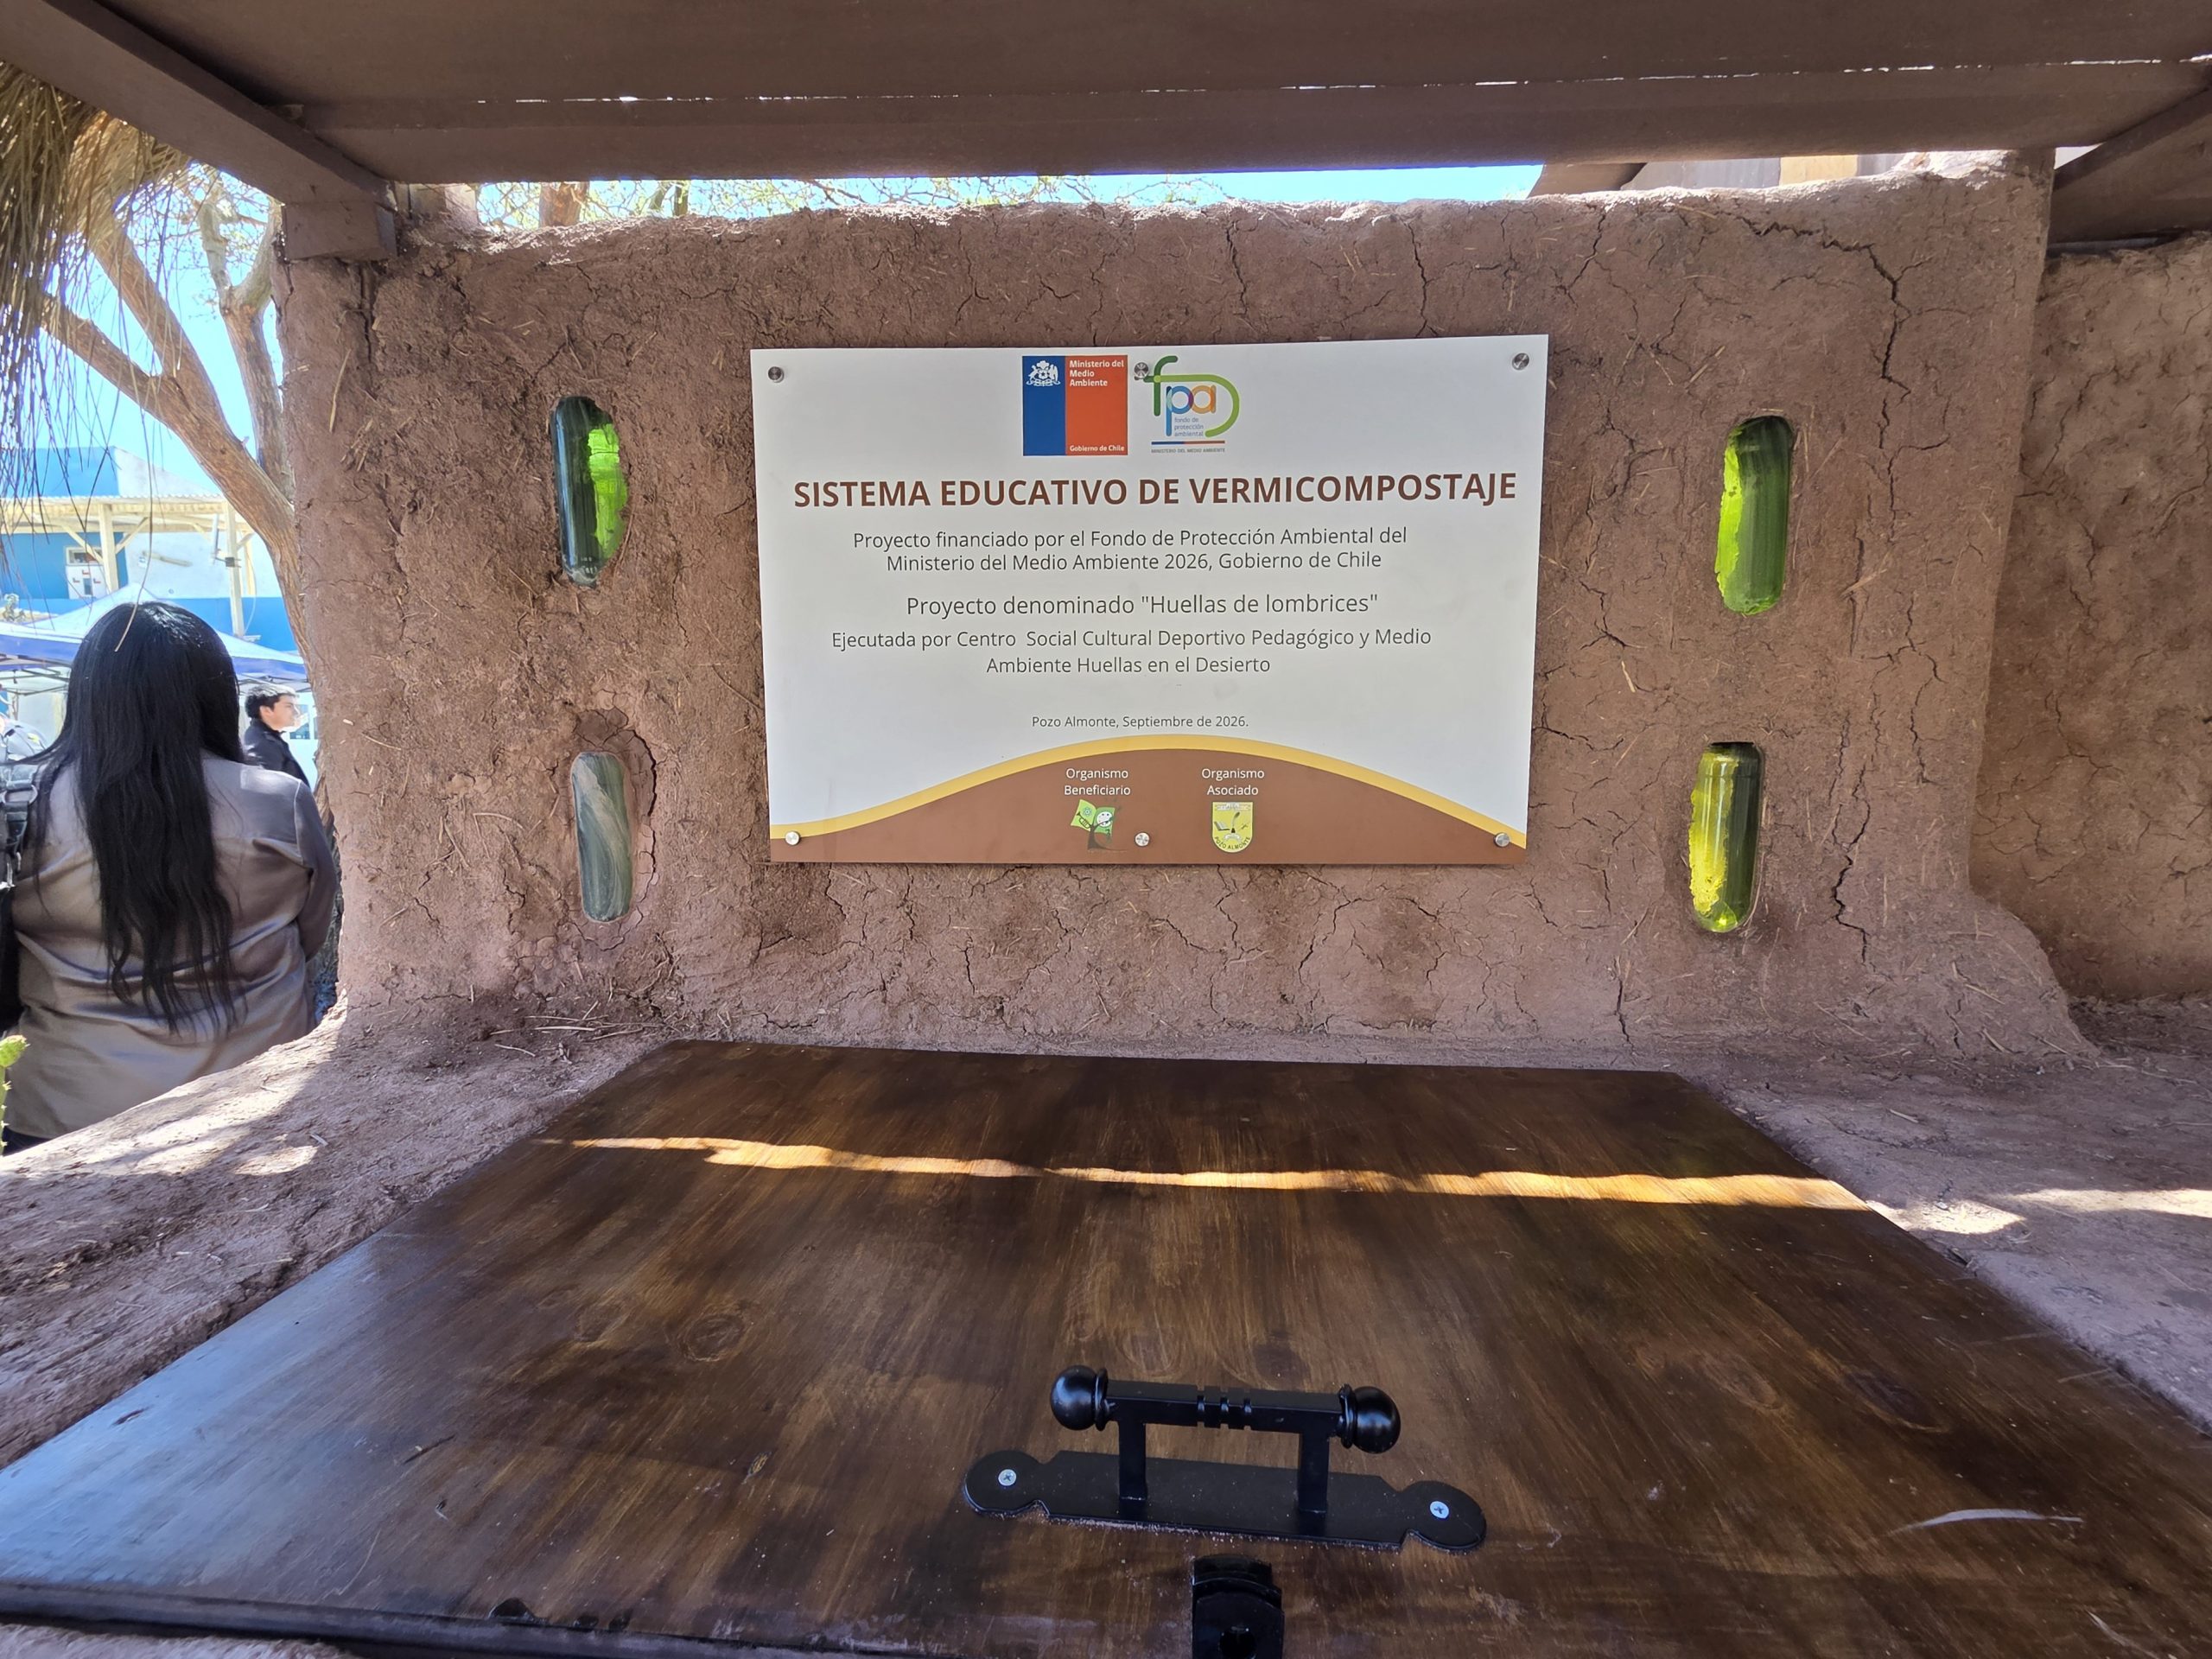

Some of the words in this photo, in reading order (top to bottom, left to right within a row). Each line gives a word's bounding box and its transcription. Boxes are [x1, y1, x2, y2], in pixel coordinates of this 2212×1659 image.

[1069, 359, 1110, 368] Ministerio
[794, 480, 931, 508] SISTEMA
[940, 479, 1128, 506] EDUCATIVO
[1139, 478, 1179, 505] DE
[1188, 472, 1516, 507] VERMICOMPOSTAJE
[854, 532, 931, 553] Proyecto
[935, 530, 1029, 548] financiado
[1034, 534, 1065, 552] por
[1070, 530, 1084, 547] el
[1091, 529, 1147, 547] Fondo
[1152, 529, 1174, 546] de
[1180, 528, 1274, 546] Protección
[1280, 526, 1373, 545] Ambiental
[1379, 525, 1407, 543] del
[886, 555, 975, 571] Ministerio
[980, 554, 1007, 571] del
[1013, 554, 1068, 570] Medio
[1071, 553, 1160, 570] Ambiente
[1164, 553, 1213, 572] 2026,
[1218, 551, 1303, 569] Gobierno
[1308, 550, 1332, 569] de
[1337, 550, 1382, 568] Chile
[907, 597, 996, 620] Proyecto
[1003, 594, 1135, 614] denominado
[1141, 594, 1227, 614] "Huellas
[1233, 594, 1259, 613] de
[1266, 593, 1378, 613] lombrices"
[832, 631, 916, 652] Ejecutada
[921, 634, 952, 652] por
[957, 631, 1016, 647] Centro
[1026, 629, 1077, 647] Social
[1083, 629, 1152, 646] Cultural
[1158, 629, 1246, 651] Deportivo
[1252, 628, 1354, 650] Pedagógico
[1358, 632, 1370, 650] y
[1375, 627, 1432, 645] Medio
[986, 657, 1071, 673] Ambiente
[1077, 656, 1142, 673] Huellas
[1147, 660, 1169, 673] en
[1174, 656, 1190, 673] el
[1196, 656, 1270, 673] Desierto
[1032, 716, 1061, 728] Pozo
[1064, 715, 1119, 728] Almonte,
[1122, 715, 1193, 730] Septiembre
[1196, 715, 1212, 728] de
[1215, 715, 1249, 728] 2026.
[1065, 767, 1128, 782] Organismo
[1201, 767, 1265, 782] Organismo
[1064, 784, 1131, 796] Beneficiario
[1206, 784, 1259, 796] Asociado
[1214, 836, 1227, 849] POZO
[1227, 836, 1251, 849] ALMONTE
